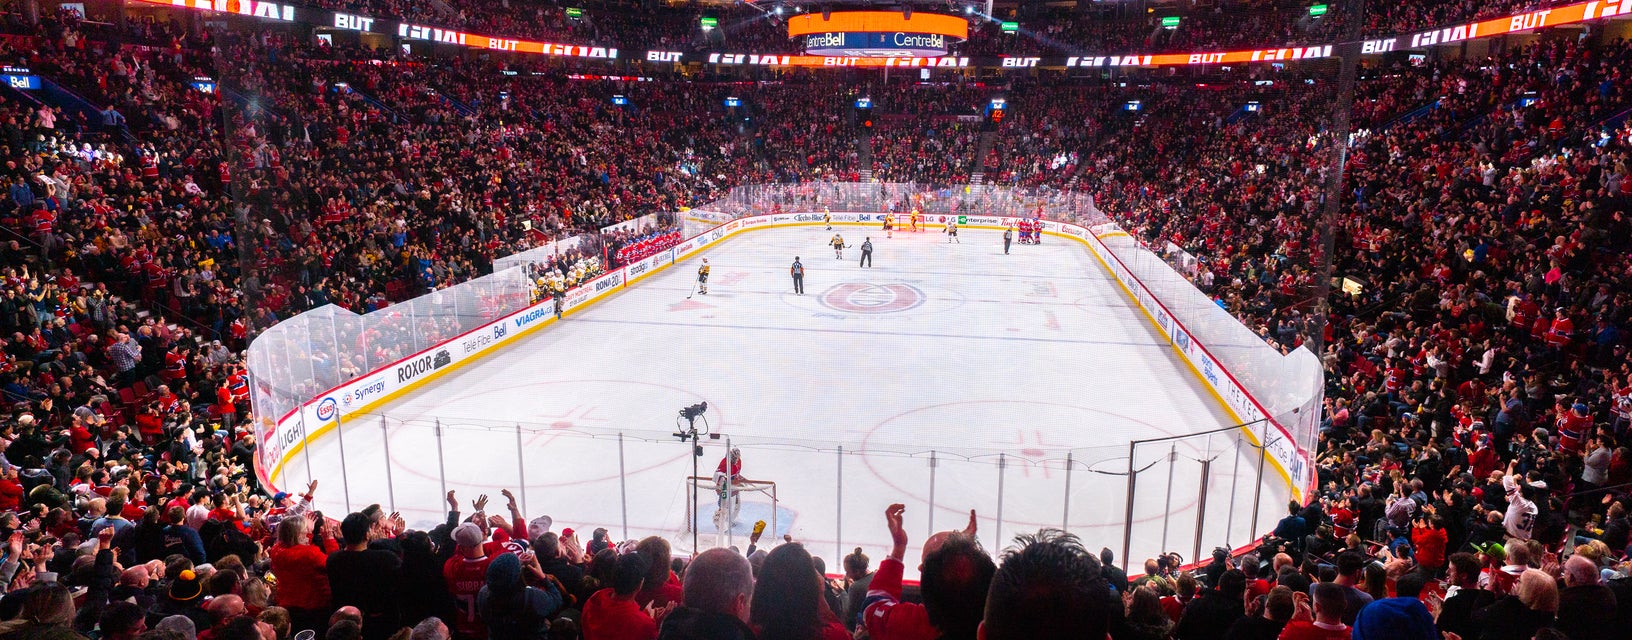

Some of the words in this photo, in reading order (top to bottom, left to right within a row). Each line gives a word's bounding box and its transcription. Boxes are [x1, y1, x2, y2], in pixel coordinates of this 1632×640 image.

[334, 13, 374, 31] BUT
[488, 38, 519, 50] BUT
[647, 51, 683, 62] BUT
[823, 58, 860, 66] BUT
[1002, 57, 1040, 66] BUT
[1188, 53, 1226, 64] BUT
[1361, 38, 1396, 54] BUT
[1509, 10, 1550, 32] BUT
[10, 76, 30, 88] Bell
[596, 278, 612, 292] RONA
[494, 323, 507, 339] Bell
[397, 355, 433, 383] ROXOR
[354, 380, 386, 401] Synergy
[1227, 380, 1240, 403] THE
[319, 405, 335, 416] Esso
[280, 420, 303, 450] LIGHT
